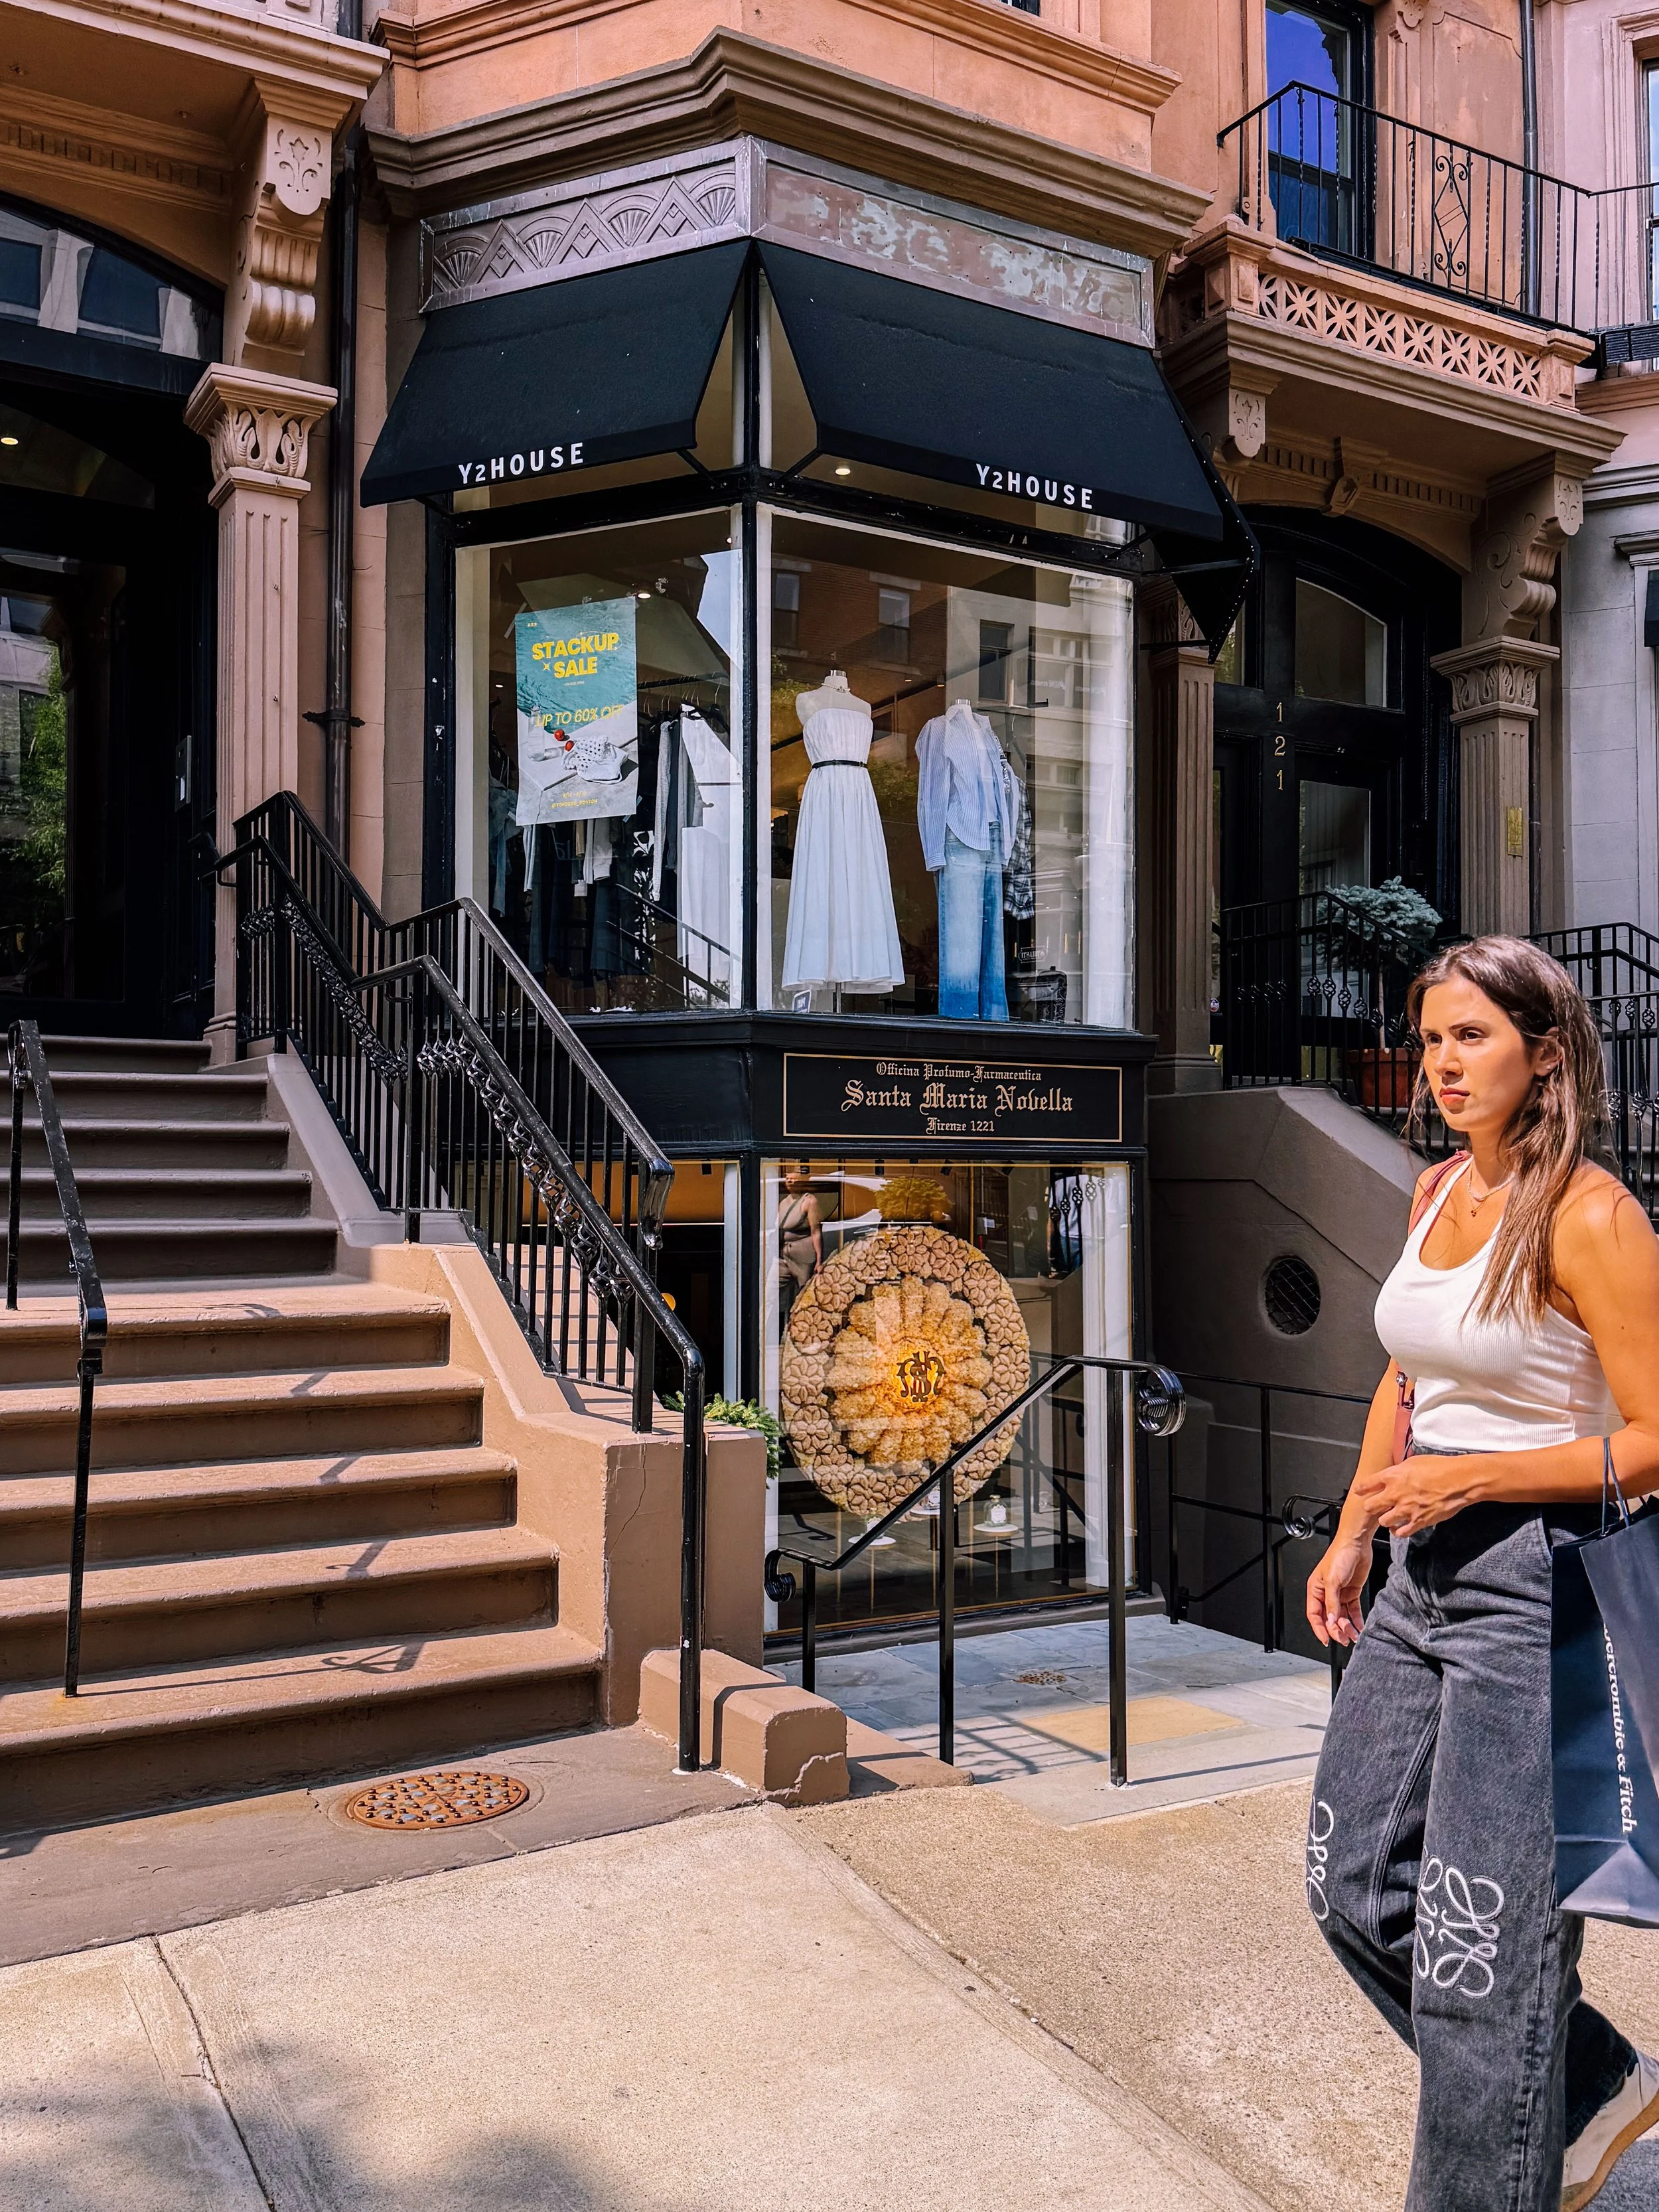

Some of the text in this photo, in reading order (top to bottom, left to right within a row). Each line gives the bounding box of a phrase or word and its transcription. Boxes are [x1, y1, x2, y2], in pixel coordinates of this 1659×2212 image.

[459, 442, 583, 484] Y2HOUSE
[975, 463, 1093, 510] Y2HOUSE
[532, 632, 619, 660] STACKUP
[553, 656, 597, 678] SALE
[536, 704, 625, 727] UP TO 60% OFF
[876, 1062, 920, 1076] Officina
[841, 1079, 1073, 1117] Santa Maria Novella
[926, 1117, 995, 1134] Firenze 1221
[1603, 1623, 1638, 1832] ercrombie & Fitch
